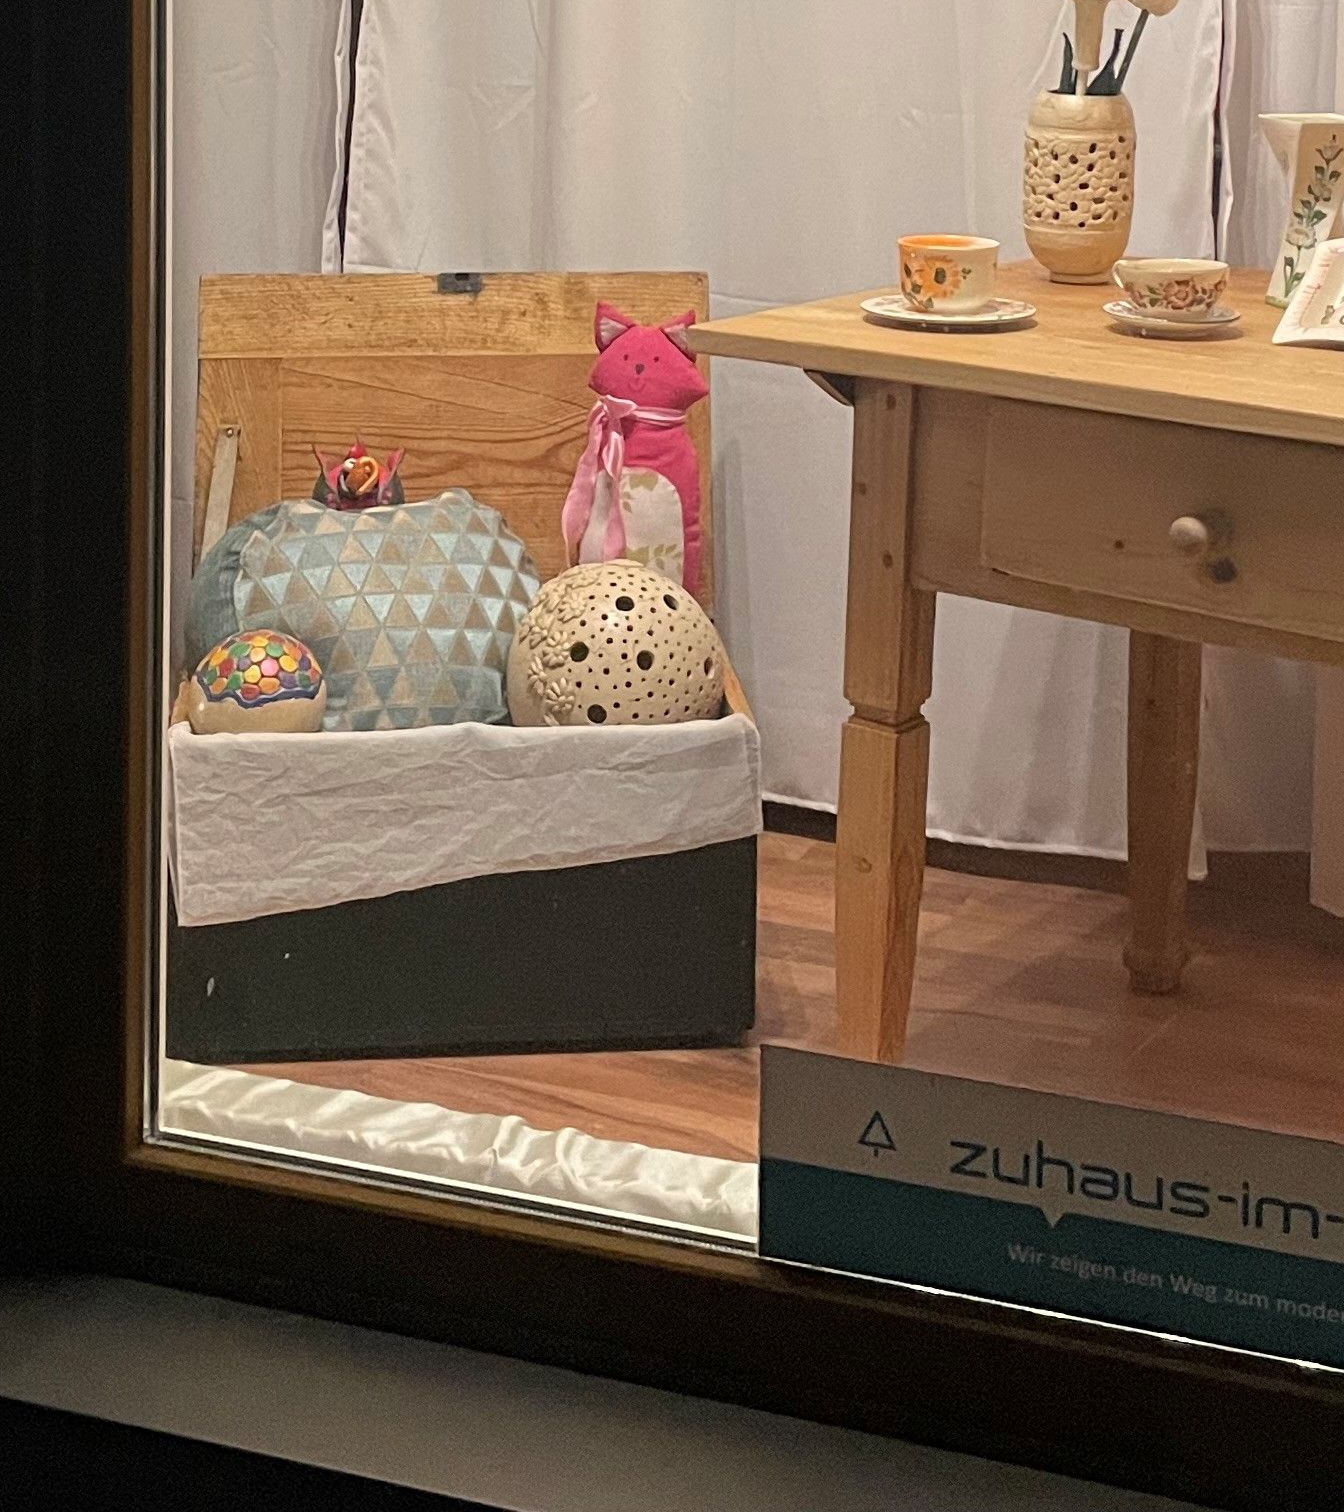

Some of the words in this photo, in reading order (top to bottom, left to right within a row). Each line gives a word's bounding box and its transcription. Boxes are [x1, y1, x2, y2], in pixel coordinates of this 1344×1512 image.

[1007, 1242, 1045, 1265] Wir
[1050, 1252, 1117, 1281] zeigen
[1121, 1267, 1164, 1289] den
[1169, 1273, 1218, 1304] Weg
[1225, 1287, 1271, 1311] zum
